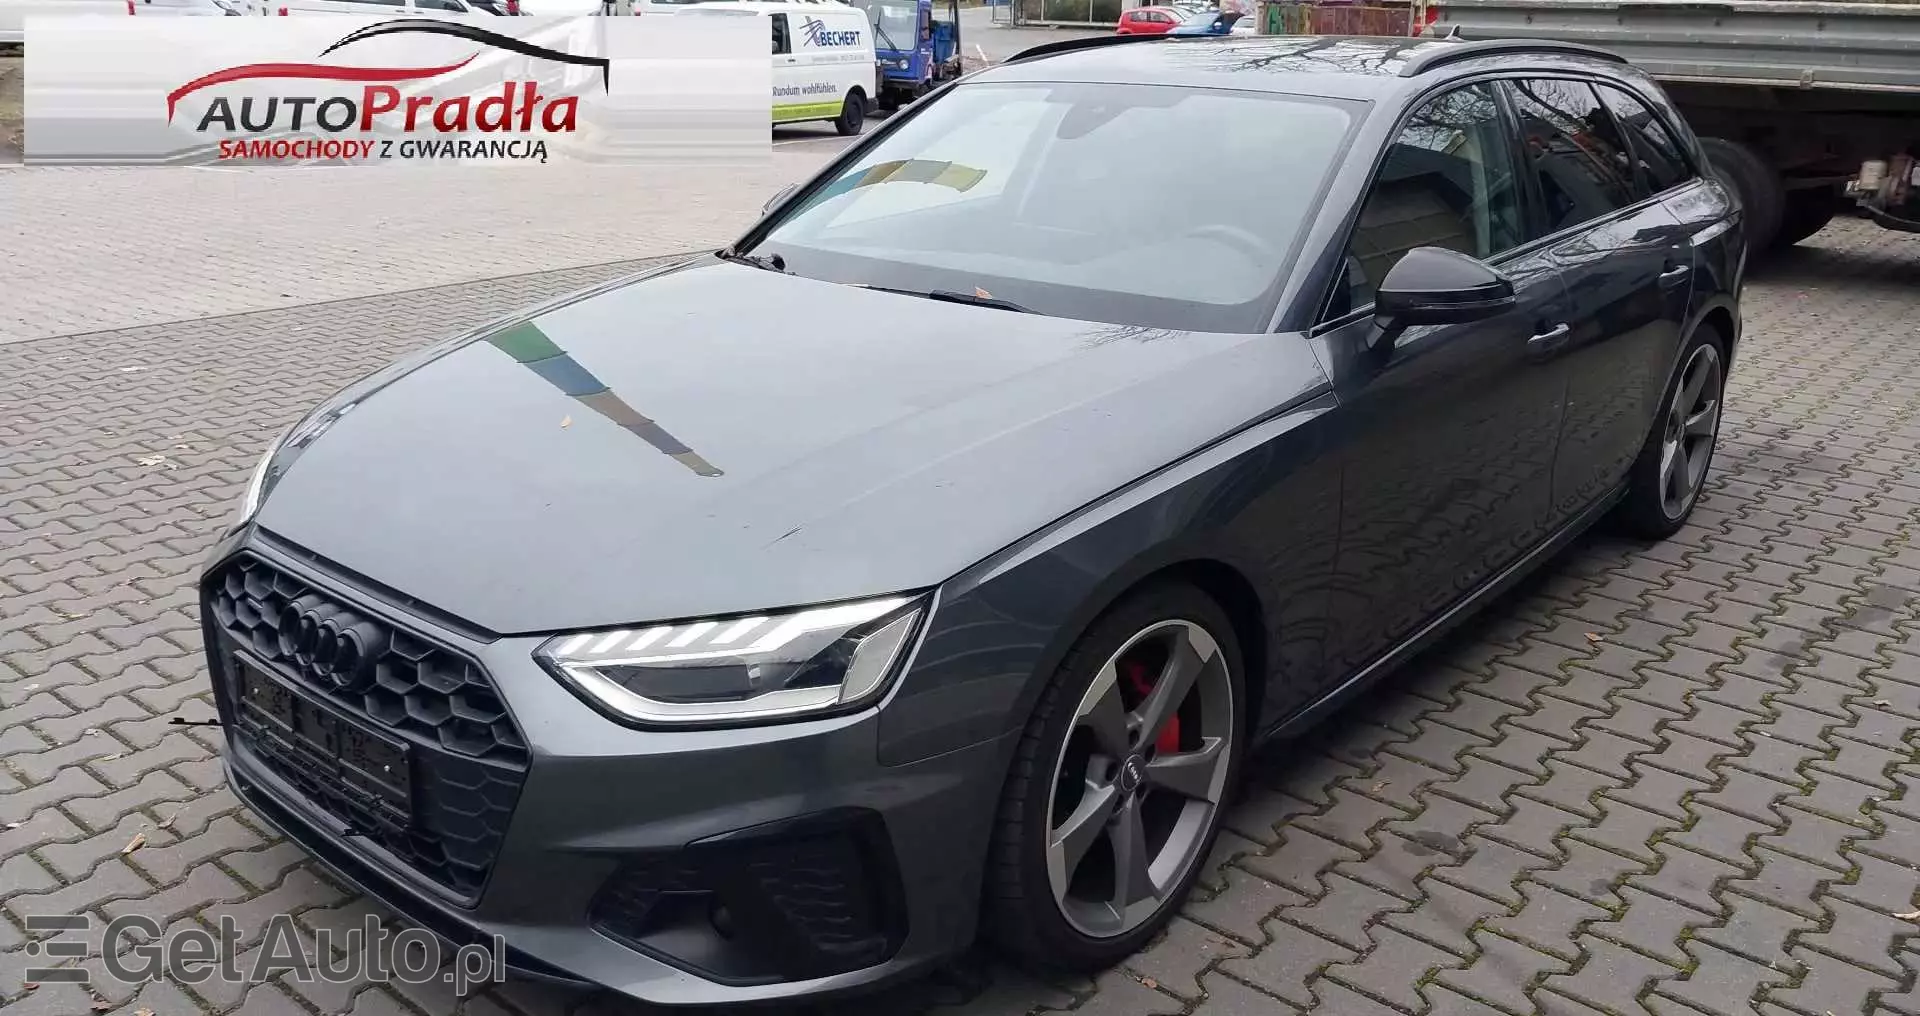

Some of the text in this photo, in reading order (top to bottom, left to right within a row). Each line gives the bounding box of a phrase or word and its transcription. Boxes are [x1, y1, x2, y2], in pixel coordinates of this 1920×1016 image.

[820, 31, 860, 47] BECHERT
[772, 82, 837, 97] Rundum wohlfühlen.
